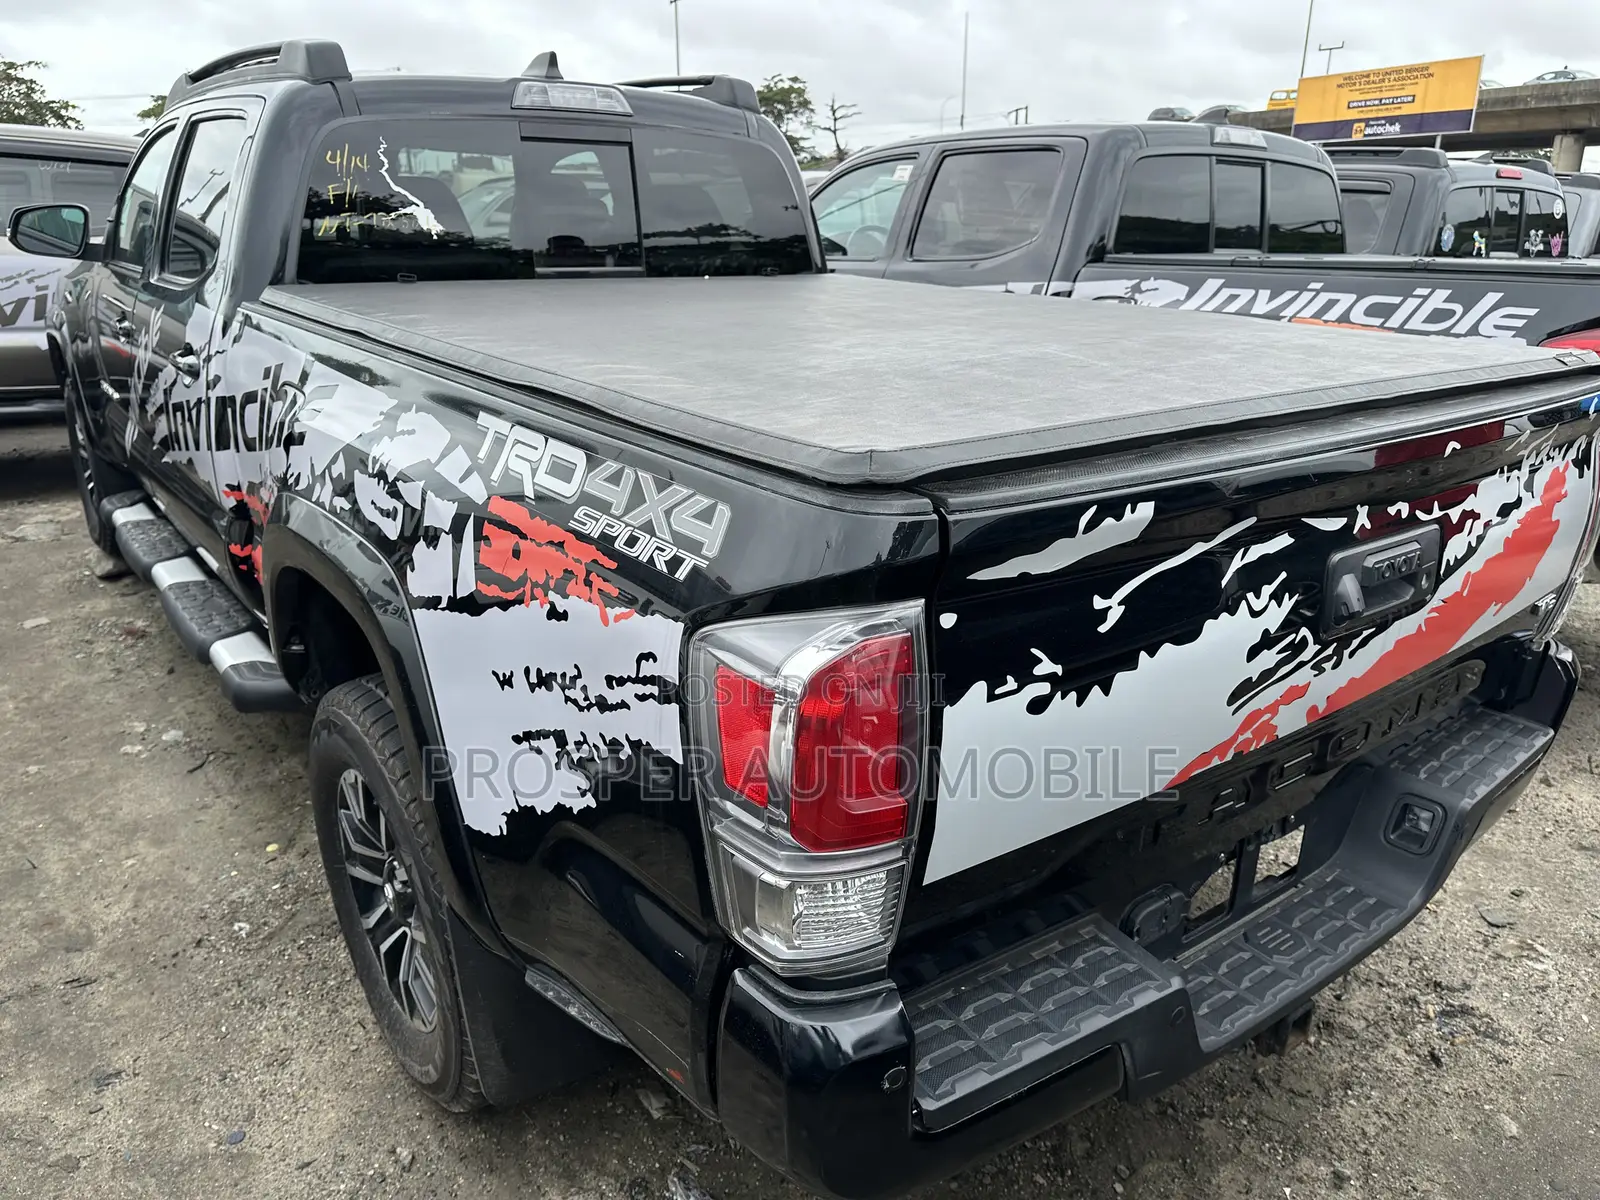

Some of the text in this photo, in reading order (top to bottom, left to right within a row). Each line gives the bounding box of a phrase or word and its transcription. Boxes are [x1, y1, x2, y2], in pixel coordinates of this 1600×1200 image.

[1342, 66, 1430, 82] WELCOME TO UNITED BERGER
[1392, 72, 1434, 83] ASSOCIATION
[1349, 100, 1365, 108] DRIVE
[1364, 122, 1401, 135] autochek
[1200, 278, 1541, 338] Invincible
[567, 505, 709, 583] SPORT
[1374, 551, 1420, 581] TOYOTA
